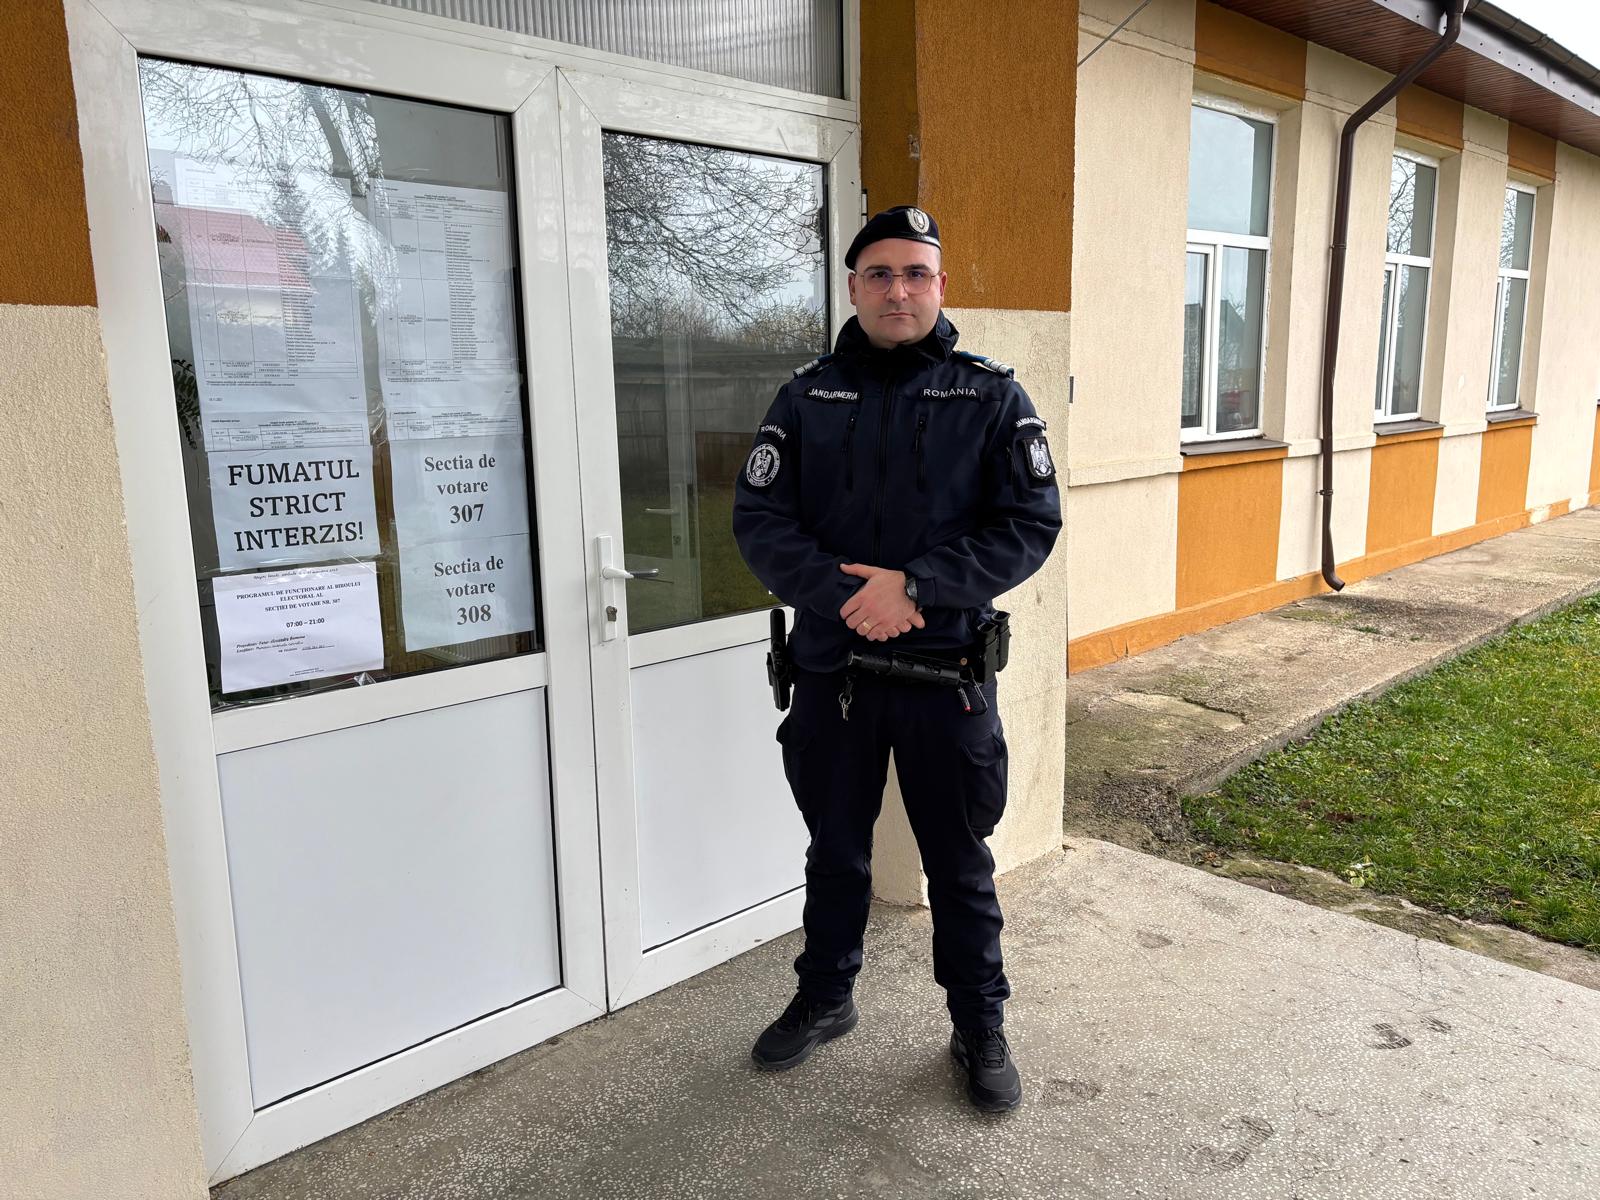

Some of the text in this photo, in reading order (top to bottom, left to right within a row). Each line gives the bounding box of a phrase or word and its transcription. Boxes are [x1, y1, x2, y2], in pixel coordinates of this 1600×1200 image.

[808, 388, 858, 400] JANDARMERIA
[923, 387, 977, 398] ROMANIA
[424, 454, 496, 472] Sectia de
[228, 460, 360, 486] FUMATUL
[437, 481, 488, 495] votare
[250, 492, 346, 517] STRICT
[450, 504, 484, 524] 307
[234, 521, 364, 552] INTERZIS!
[434, 556, 504, 577] Sectia de
[236, 590, 275, 600] PROGRAMUL
[280, 593, 314, 602] ELECTORAL
[446, 582, 496, 598] votare
[286, 620, 303, 628] 07:00
[309, 618, 325, 626] 21:00
[457, 604, 492, 626] 308
